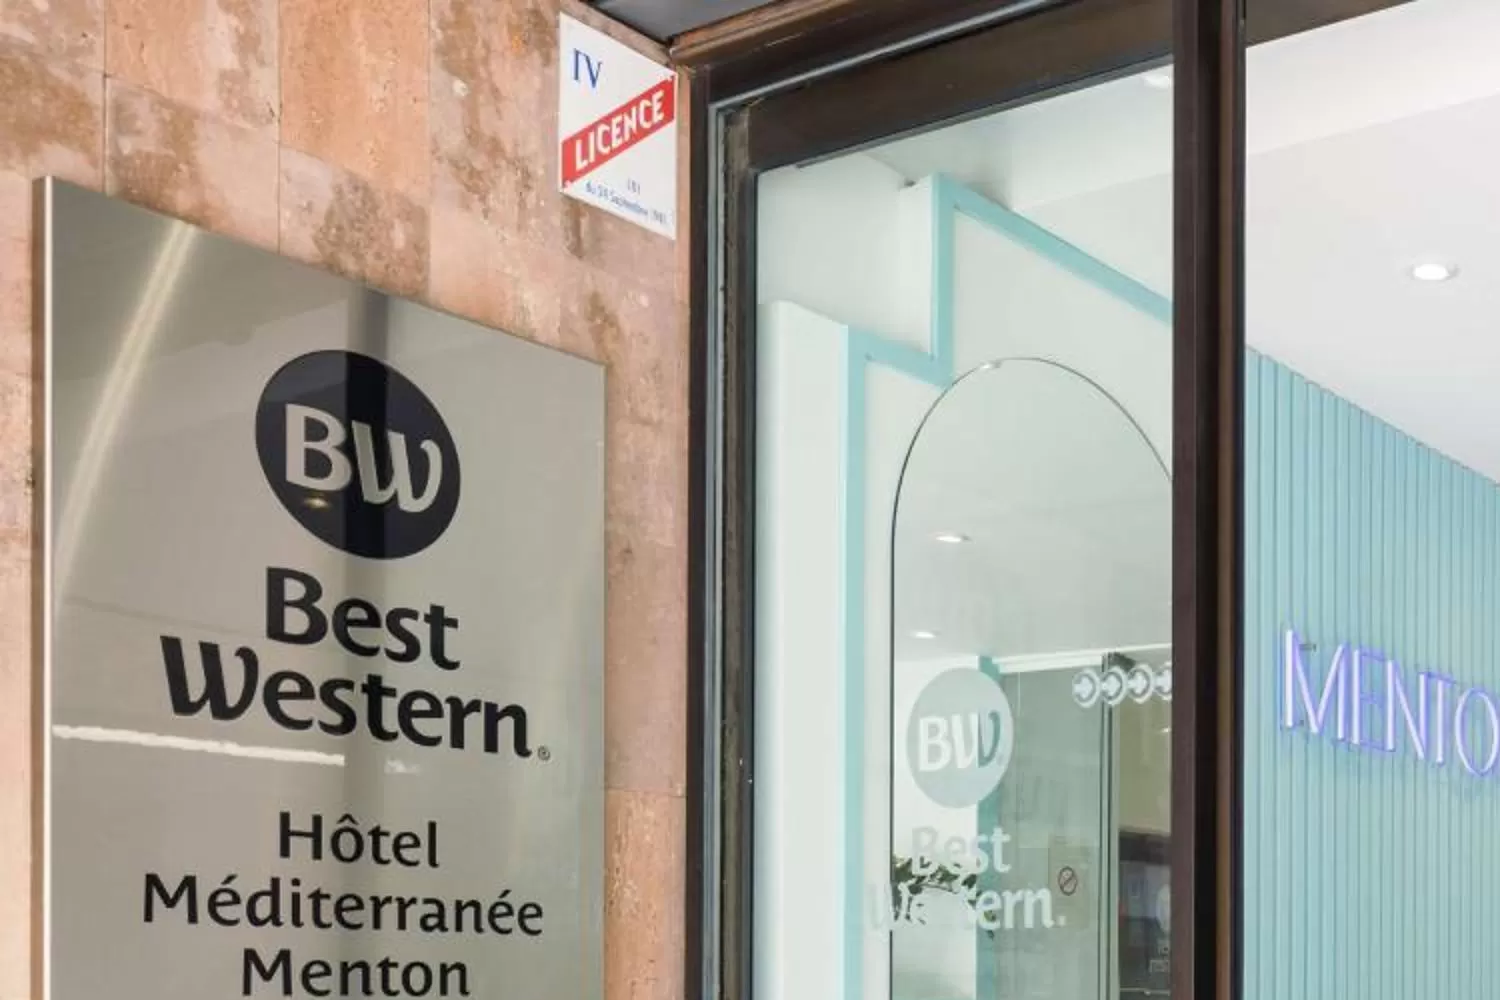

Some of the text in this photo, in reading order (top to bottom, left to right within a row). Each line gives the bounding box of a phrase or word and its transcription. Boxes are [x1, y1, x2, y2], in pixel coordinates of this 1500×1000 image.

[572, 48, 603, 89] IV
[574, 90, 665, 172] LICENCE
[285, 402, 443, 513] BW
[266, 566, 461, 671] Best
[917, 709, 1001, 773] BW
[279, 811, 440, 868] Hôtel
[143, 873, 544, 936] Méditerranée
[242, 948, 471, 998] Menton
